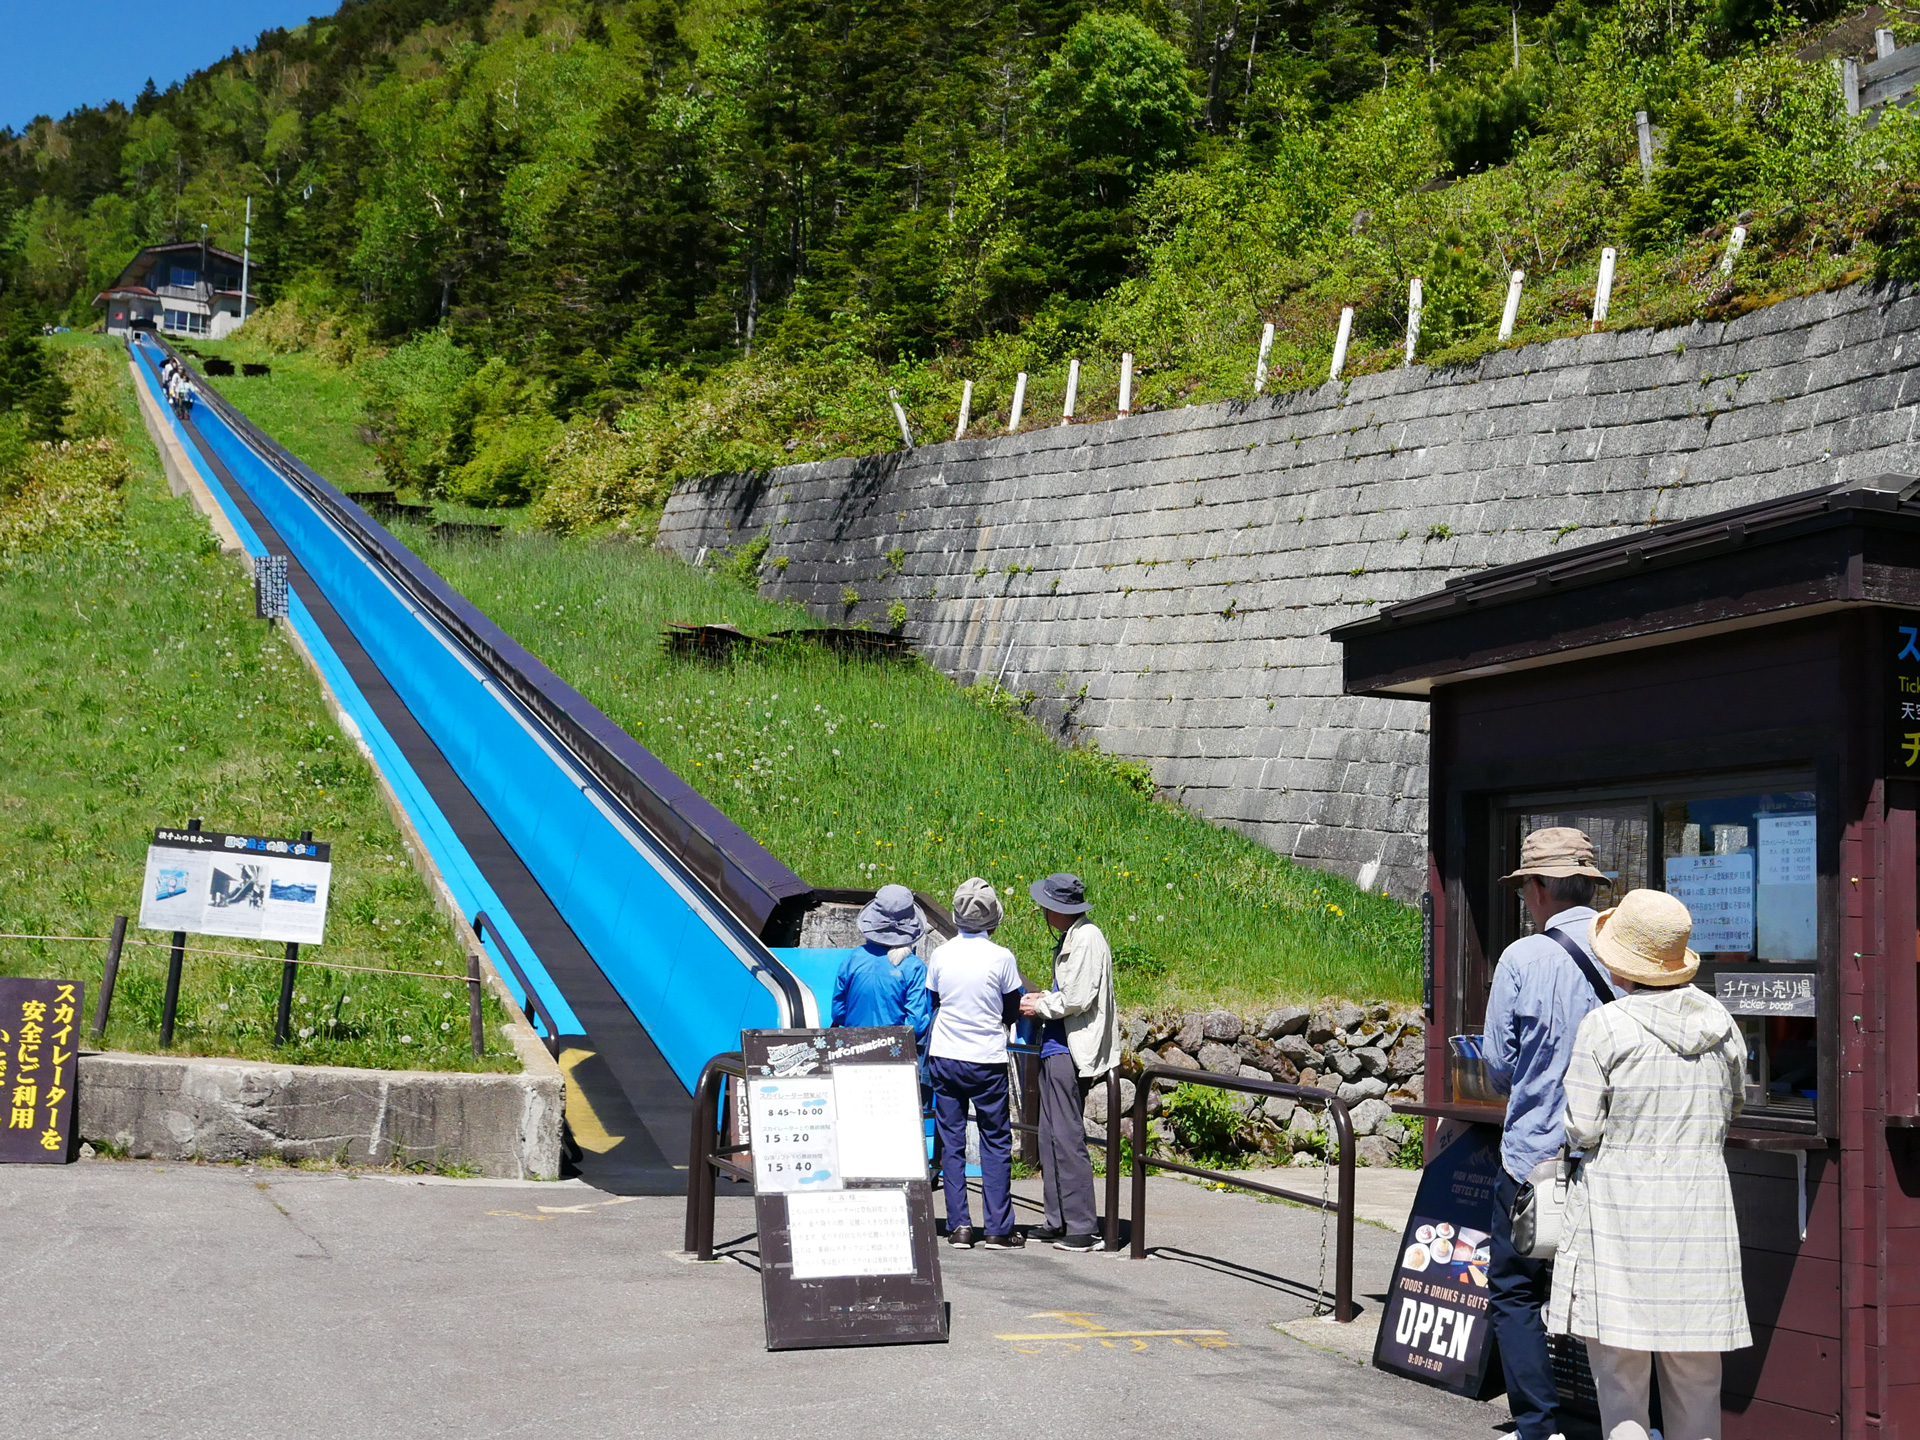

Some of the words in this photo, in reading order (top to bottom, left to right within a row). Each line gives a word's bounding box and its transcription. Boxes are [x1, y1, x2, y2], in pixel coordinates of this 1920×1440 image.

[1723, 979, 1811, 999] チケット売り場
[1739, 998, 1766, 1009] ticket
[1769, 1001, 1794, 1011] booth
[9, 999, 48, 1130] 安全にご利用
[40, 983, 77, 1151] スカイレーターを
[1451, 1184, 1473, 1196] COFFEE
[1399, 1277, 1423, 1294] FOODS
[1424, 1284, 1430, 1295] &
[1430, 1285, 1459, 1303] DRINKS
[1459, 1294, 1466, 1304] &
[1466, 1294, 1489, 1311] GUTS
[1395, 1297, 1476, 1362] OPEN
[1407, 1353, 1443, 1372] 9:00-15:00
